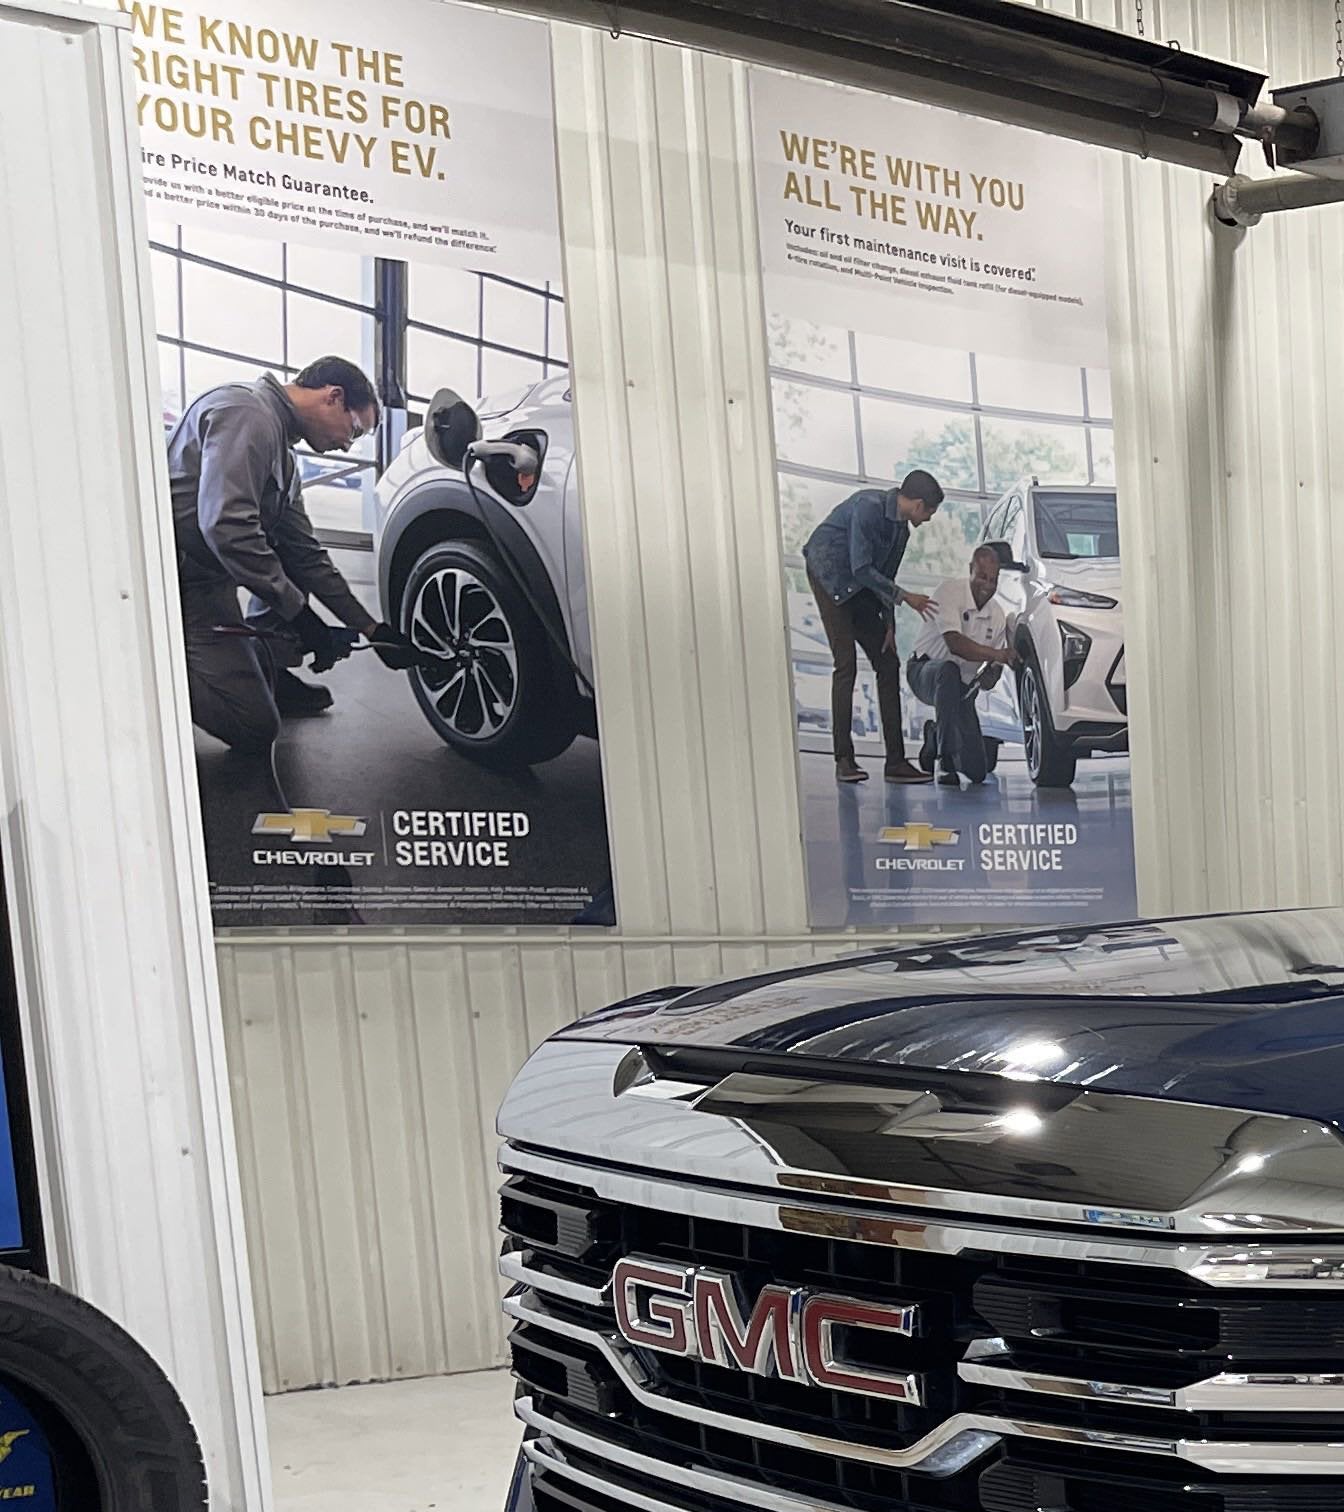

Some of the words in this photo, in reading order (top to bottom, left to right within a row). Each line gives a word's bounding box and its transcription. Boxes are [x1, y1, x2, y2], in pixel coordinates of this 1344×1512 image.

[117, 0, 185, 44] WE
[199, 15, 318, 70] KNOW
[331, 41, 404, 87] THE
[132, 46, 244, 100] RIGHT
[257, 71, 368, 124] TIRES
[381, 95, 451, 139] FOR
[137, 94, 235, 144] YOUR
[249, 115, 377, 169] CHEVY
[391, 140, 446, 181] EV.
[171, 154, 217, 176] Price
[223, 163, 276, 187] Match
[281, 174, 374, 203] Guarantee.
[780, 129, 876, 181] WE'RE
[885, 154, 960, 199] WITH
[969, 170, 1025, 211] YOU
[164, 192, 194, 204] better
[197, 200, 220, 210] price
[223, 202, 251, 214] within
[267, 210, 288, 222] days
[291, 214, 299, 223] of
[302, 215, 316, 226] the
[319, 219, 362, 234] purchase,
[364, 225, 379, 236] and
[403, 232, 432, 244] refund
[435, 237, 448, 246] the
[184, 183, 204, 194] with
[215, 189, 244, 201] better
[247, 195, 279, 208] eligible
[282, 201, 304, 213] price
[319, 206, 332, 216] the
[335, 209, 355, 220] time
[357, 212, 366, 221] of
[368, 215, 411, 229] purchase,
[413, 222, 427, 231] and
[451, 228, 478, 239] match
[784, 171, 841, 212] ALL
[849, 185, 907, 226] THE
[915, 199, 983, 241] WAY.
[784, 218, 817, 238] Your
[819, 227, 850, 247] first
[853, 238, 937, 264] maintenance
[940, 252, 967, 270] visit
[970, 257, 980, 272] is
[393, 809, 530, 837] CERTIFIED
[978, 823, 1078, 846] CERTIFIED
[252, 850, 375, 866] CHEVROLET
[395, 840, 510, 867] SERVICE
[876, 857, 965, 872] CHEVROLET
[980, 849, 1063, 871] SERVICE
[613, 1251, 925, 1406] GMC
